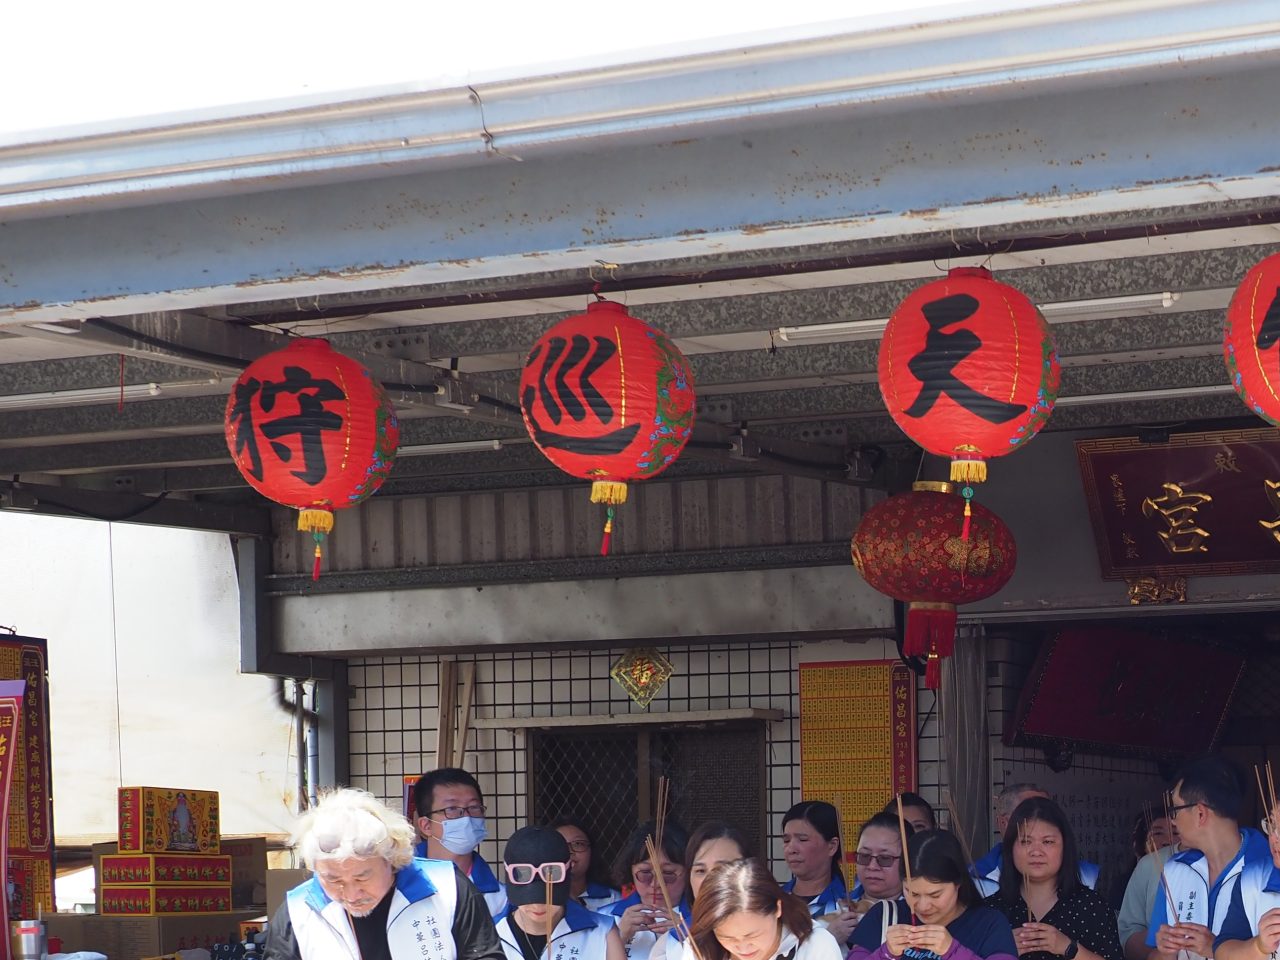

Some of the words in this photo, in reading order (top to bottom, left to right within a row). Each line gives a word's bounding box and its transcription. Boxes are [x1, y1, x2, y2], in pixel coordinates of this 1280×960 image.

[523, 334, 642, 456] 巡
[901, 294, 1024, 423] 天
[229, 366, 346, 486] 狩
